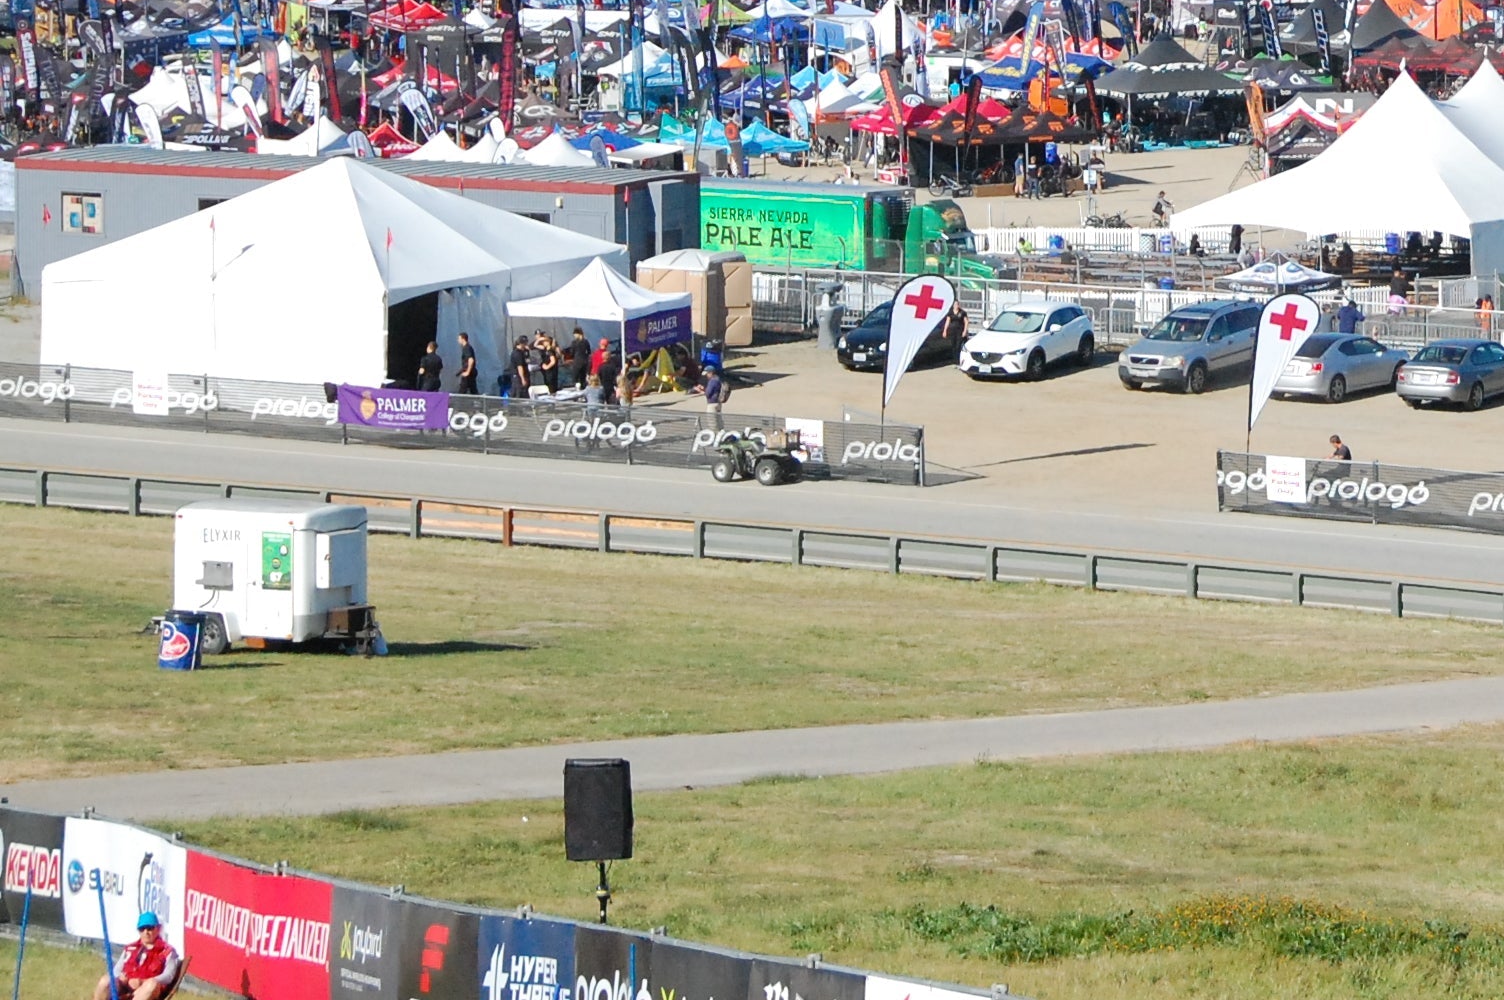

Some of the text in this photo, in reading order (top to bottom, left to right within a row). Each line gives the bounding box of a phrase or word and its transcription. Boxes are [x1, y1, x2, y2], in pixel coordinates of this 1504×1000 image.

[709, 207, 809, 224] SIERRA NEVADA
[706, 222, 813, 249] PALE ALE
[648, 316, 678, 333] PALMER
[377, 397, 426, 413] PALMER
[542, 417, 657, 447] prologo
[1306, 478, 1430, 509] prologo
[203, 527, 241, 543] ELYXIR
[6, 843, 61, 896] KENDA
[185, 888, 250, 950] SPECIALIZED
[250, 913, 331, 966] SPECIALIZED
[352, 925, 384, 964] jaybird
[510, 955, 558, 985] HYPER
